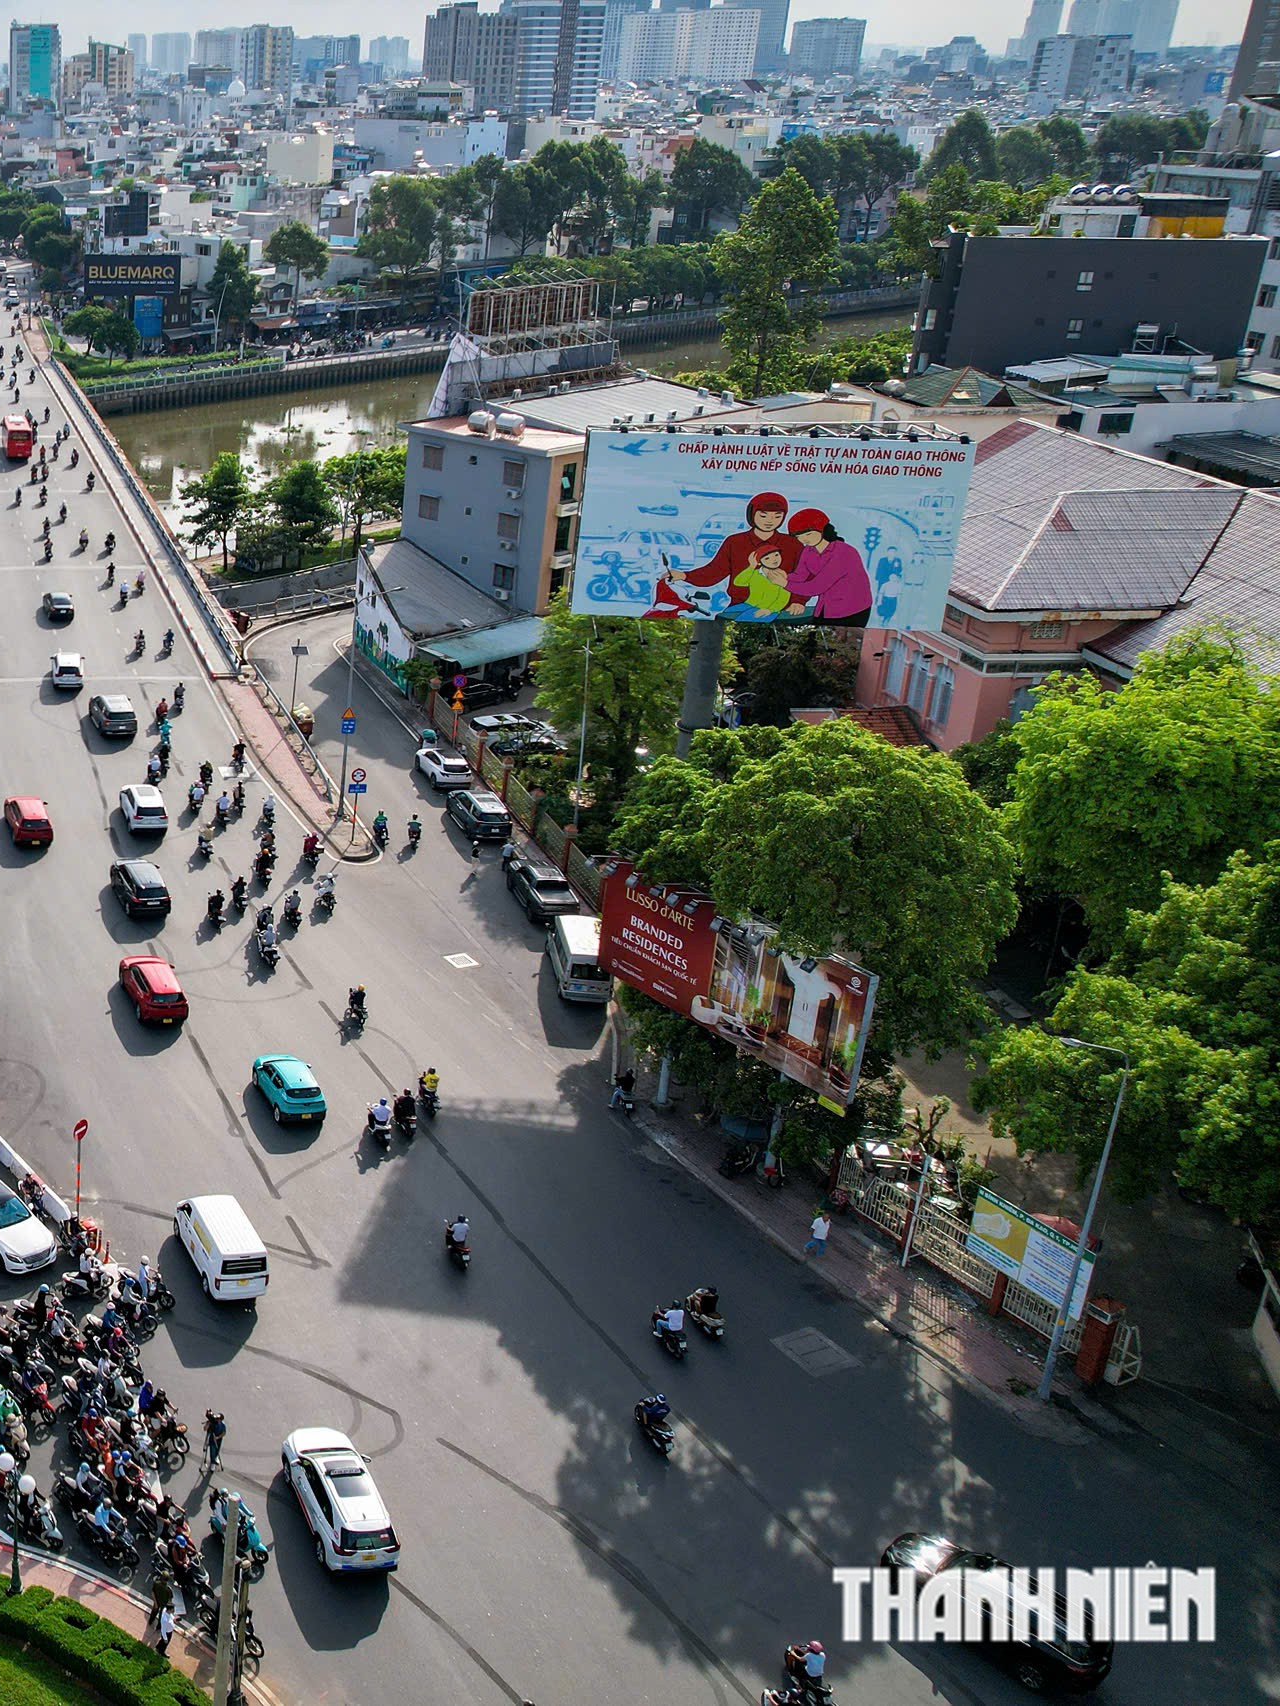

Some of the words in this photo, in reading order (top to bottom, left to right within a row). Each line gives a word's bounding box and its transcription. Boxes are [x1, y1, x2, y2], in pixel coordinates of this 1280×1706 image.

[88, 266, 174, 279] BLUEMARQ
[678, 440, 709, 454] CHẤP
[711, 442, 744, 455] HÀNH
[746, 443, 774, 458] LUẬT
[777, 443, 791, 456] VỀ
[794, 445, 822, 459] TRẬT
[824, 447, 840, 460] TỰ
[841, 448, 858, 459] AN
[861, 447, 892, 460] TOÀN
[894, 450, 922, 461] GIAO
[926, 449, 966, 463] THÔNG
[701, 457, 725, 470] XÂY
[725, 459, 757, 473] DỰNG
[760, 458, 783, 472] NẾP
[785, 459, 817, 473] SỐNG
[819, 461, 842, 474] VĂN
[845, 462, 869, 475] HÓA
[872, 464, 899, 476] GIAO
[903, 464, 942, 477] THÔNG
[626, 887, 659, 912] LUSSO
[630, 915, 683, 950] BRANDED
[622, 927, 688, 970] RESIDENCES
